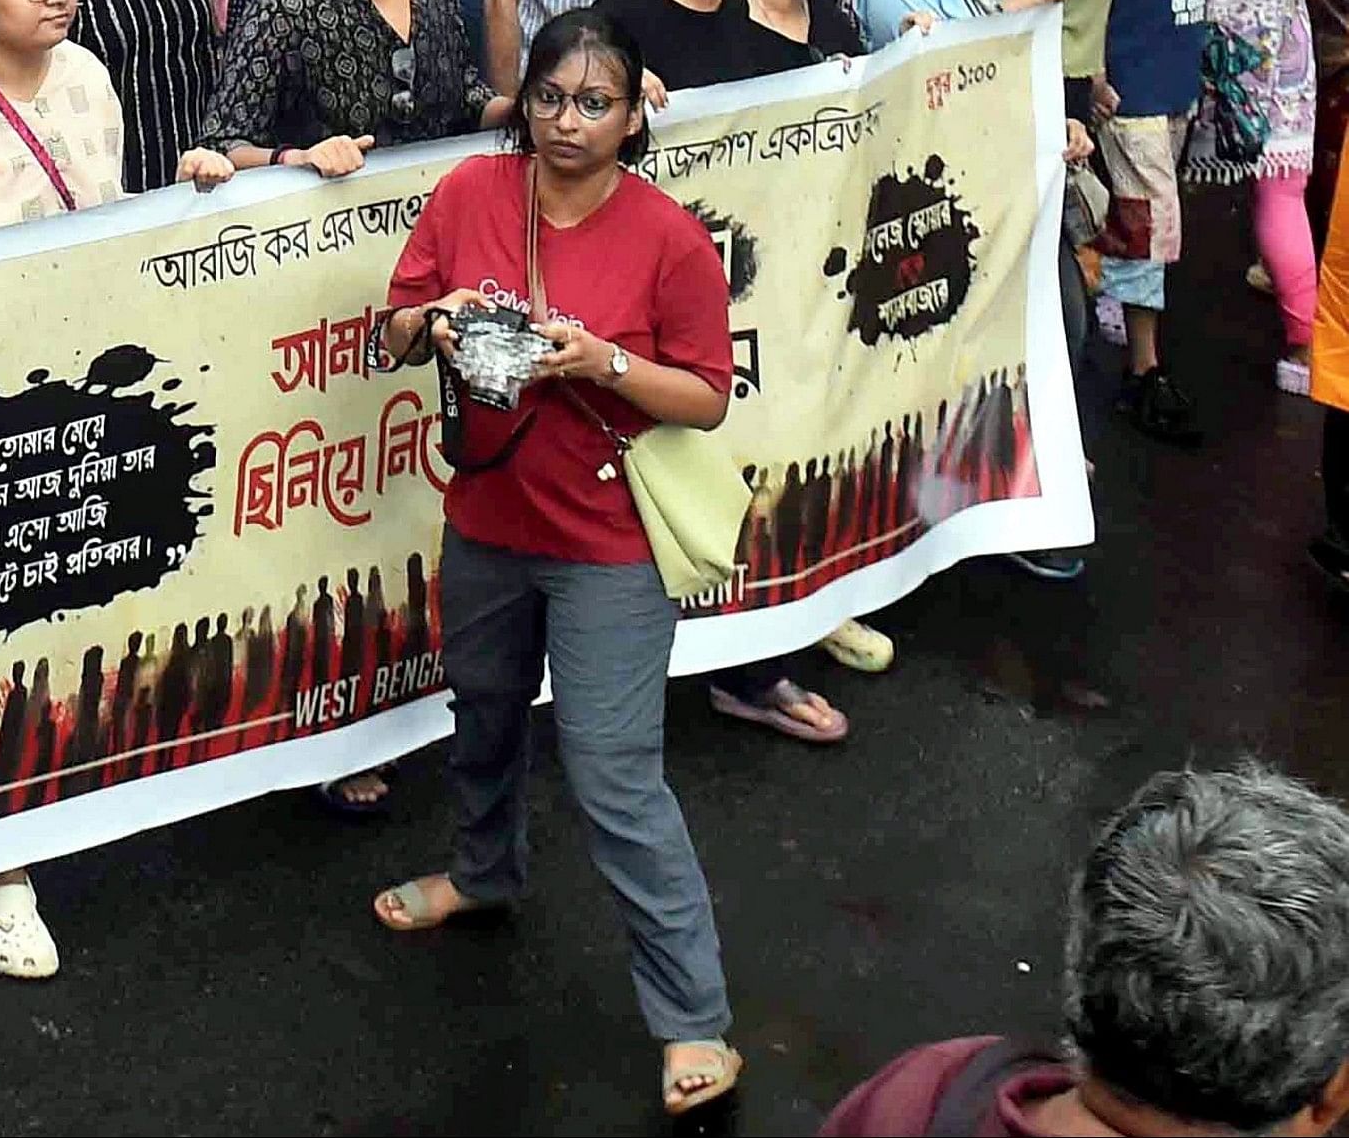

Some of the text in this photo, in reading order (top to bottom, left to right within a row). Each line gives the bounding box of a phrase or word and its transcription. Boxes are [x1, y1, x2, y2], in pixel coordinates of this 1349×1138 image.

[957, 62, 997, 92] ১:০০
[264, 219, 311, 266] কর
[317, 207, 354, 254] এর
[663, 130, 758, 179] জনগণ
[478, 278, 532, 315] Calvi
[62, 414, 106, 456] মেয়ে
[14, 469, 63, 500] আজ
[68, 451, 118, 500] দুনিয়া
[122, 444, 156, 473] তার
[232, 417, 372, 538] ছিনিয়ে
[4, 513, 50, 553] এসো
[55, 494, 111, 534] আজি
[22, 551, 60, 585] চাই
[293, 676, 362, 730] WEST
